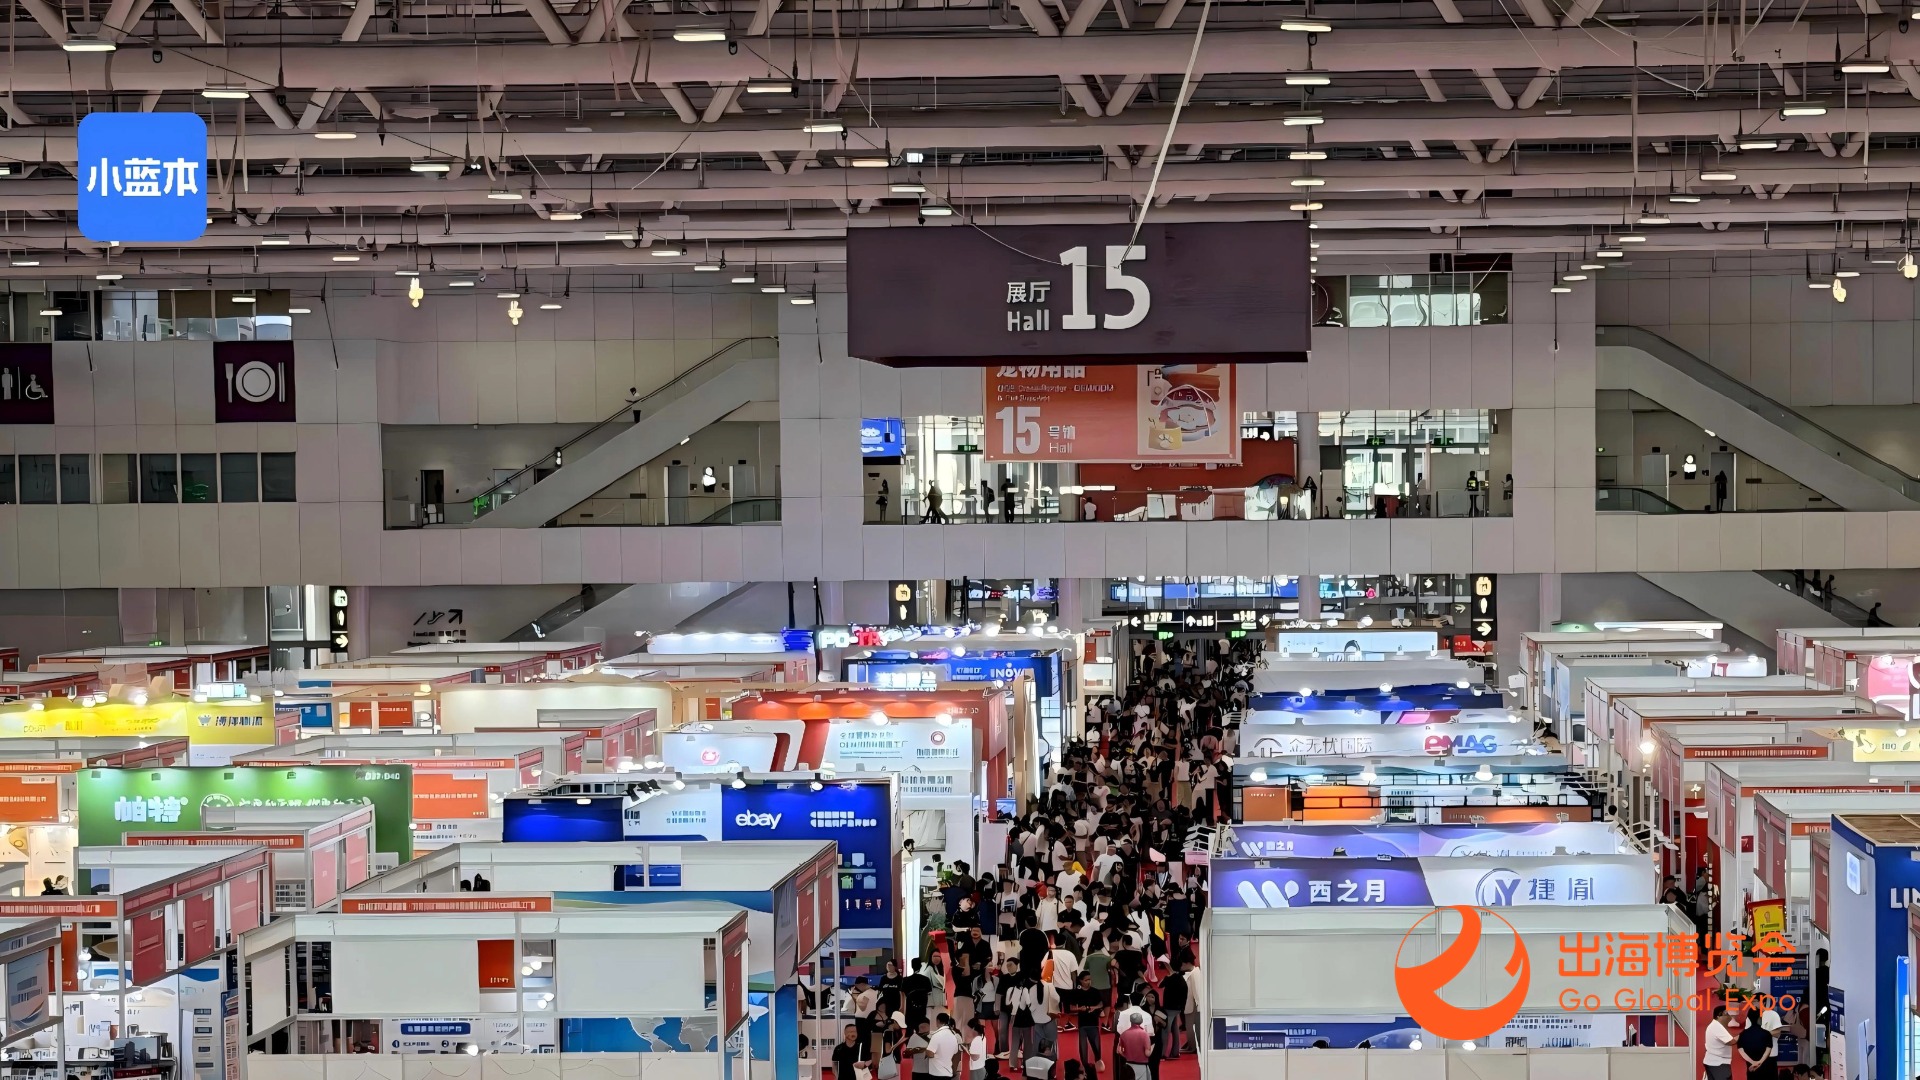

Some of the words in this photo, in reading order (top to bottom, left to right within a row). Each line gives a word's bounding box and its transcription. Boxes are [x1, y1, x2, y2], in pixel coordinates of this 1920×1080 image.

[1007, 281, 1050, 303] 展厅
[1060, 245, 1150, 330] 15
[1007, 309, 1050, 331] Hall
[995, 406, 1040, 454] 15
[735, 809, 782, 830] ebay
[1308, 879, 1385, 903] 西之月
